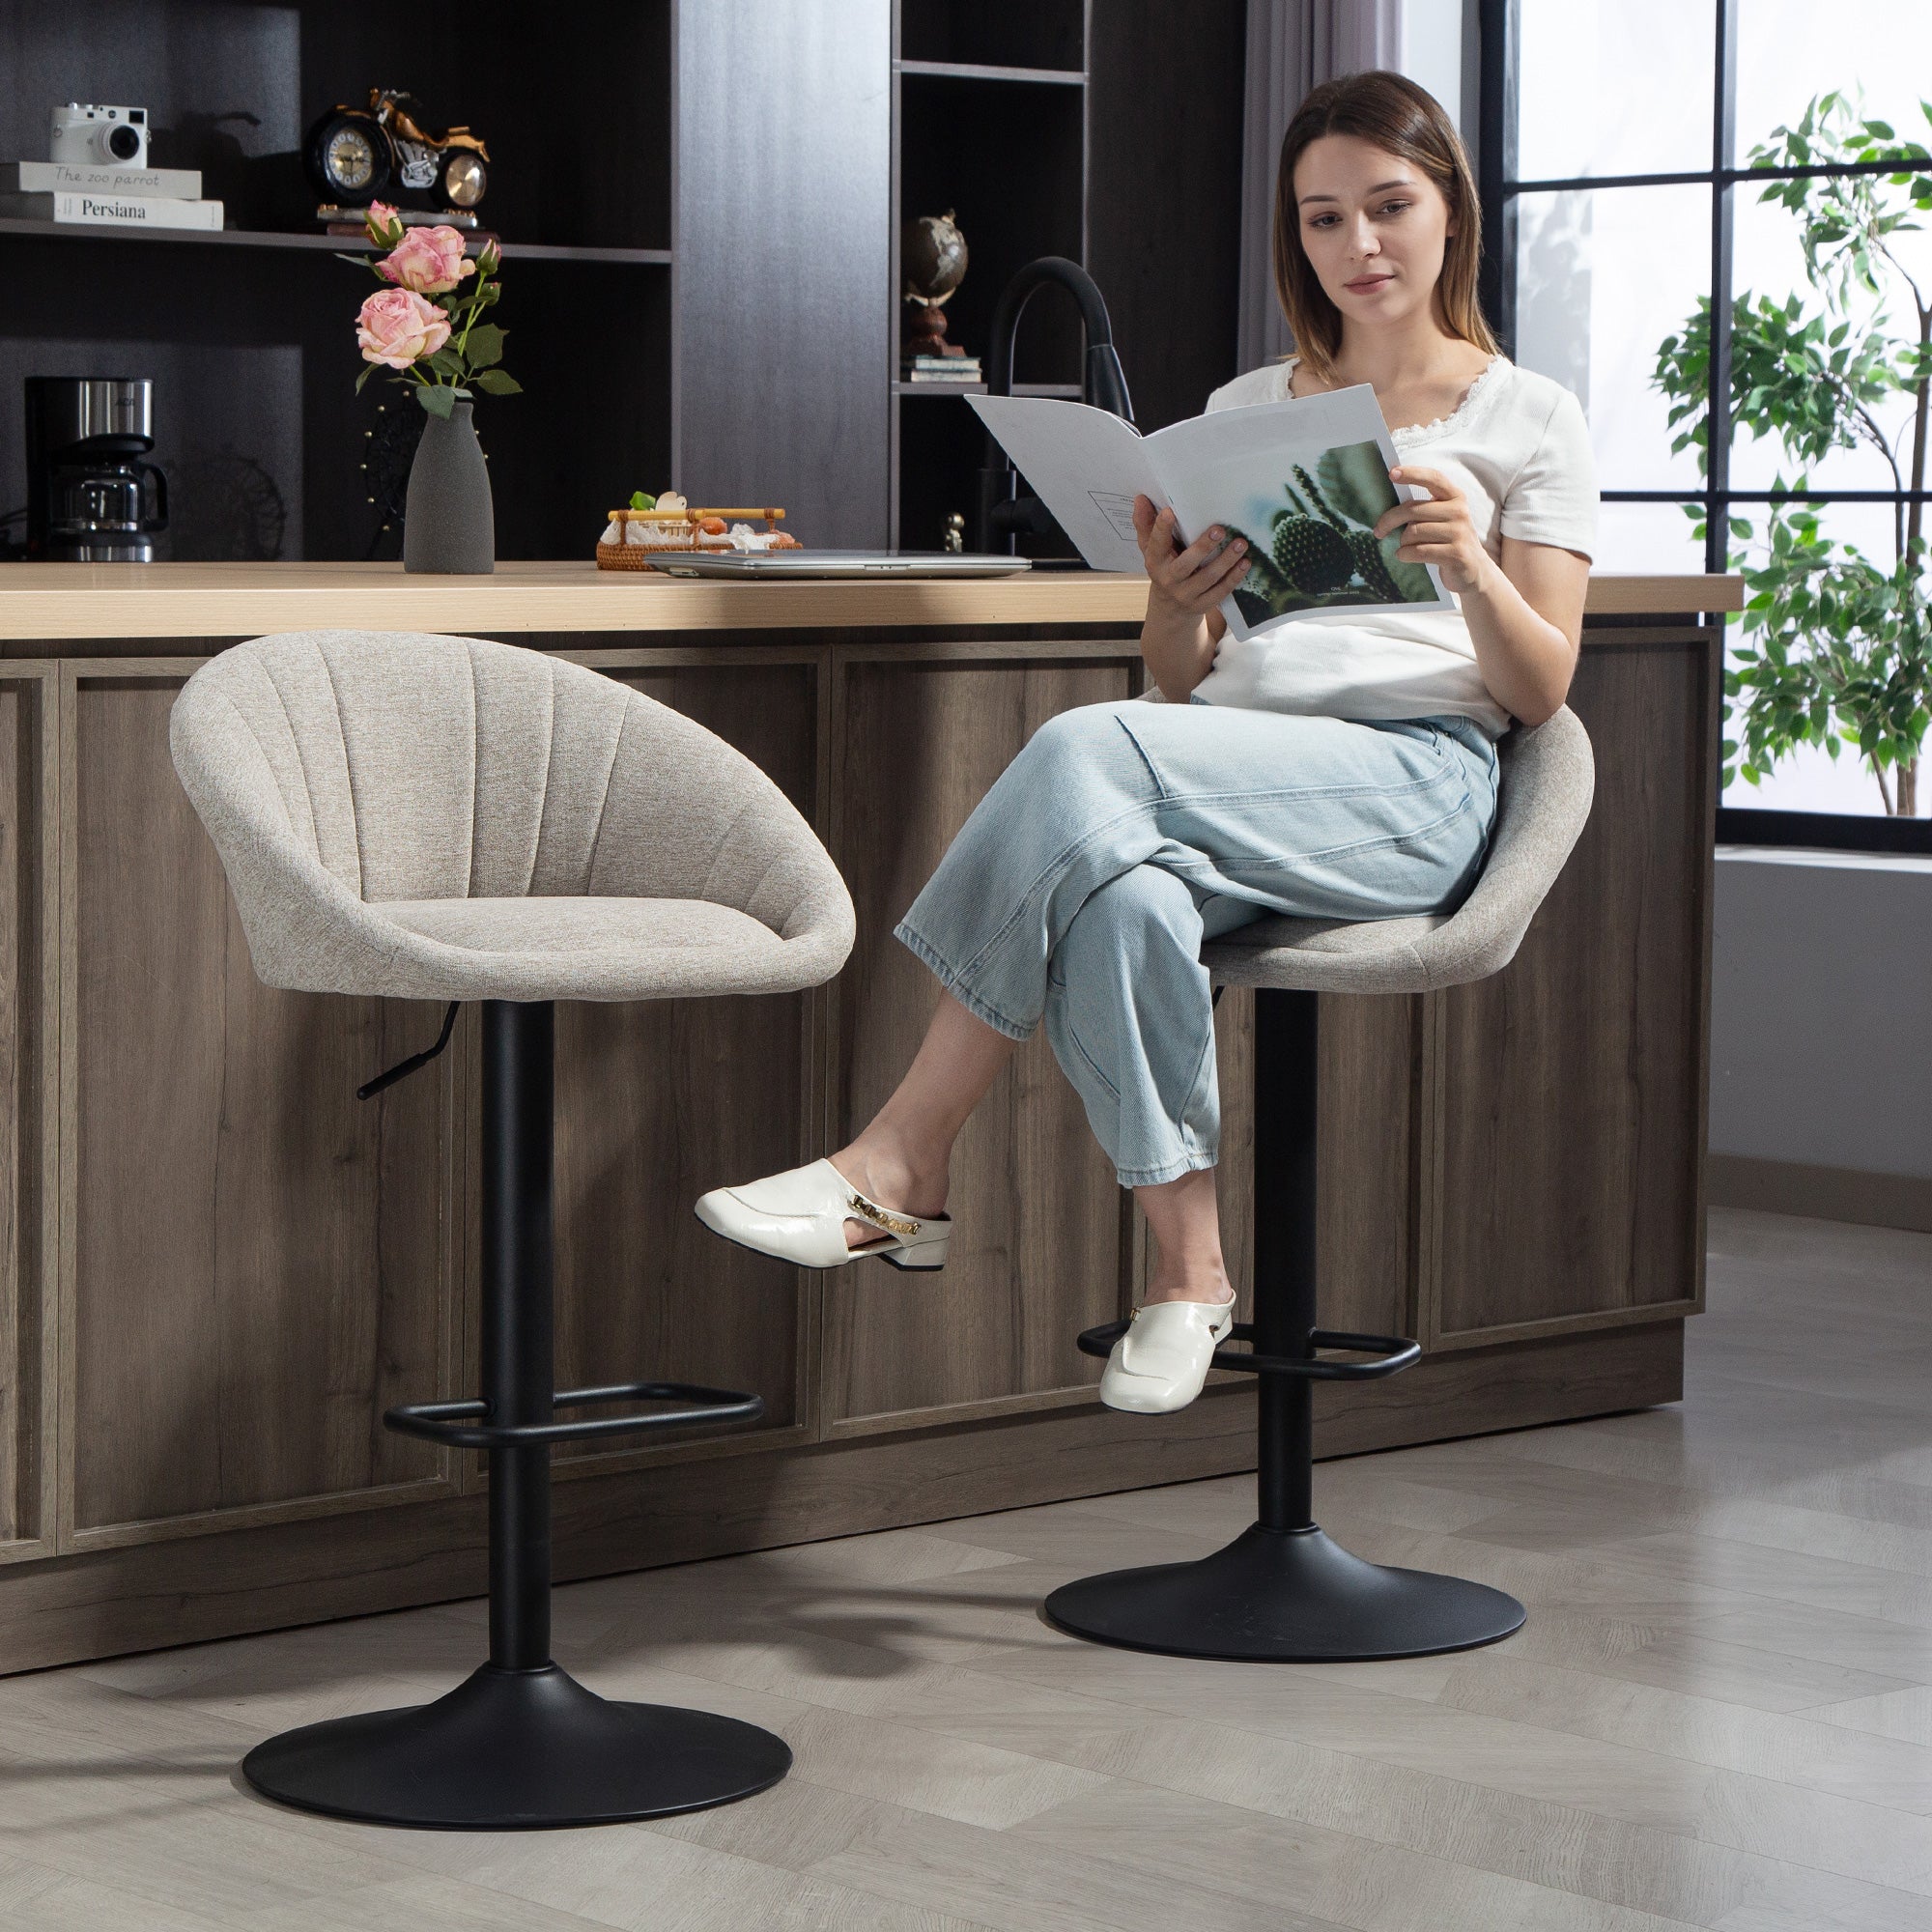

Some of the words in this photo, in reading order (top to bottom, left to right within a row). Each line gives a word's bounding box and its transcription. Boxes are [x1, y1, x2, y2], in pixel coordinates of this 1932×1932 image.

[55, 166, 81, 182] The
[88, 174, 109, 183] zoo
[113, 175, 159, 188] parrot
[82, 199, 146, 219] Persiana
